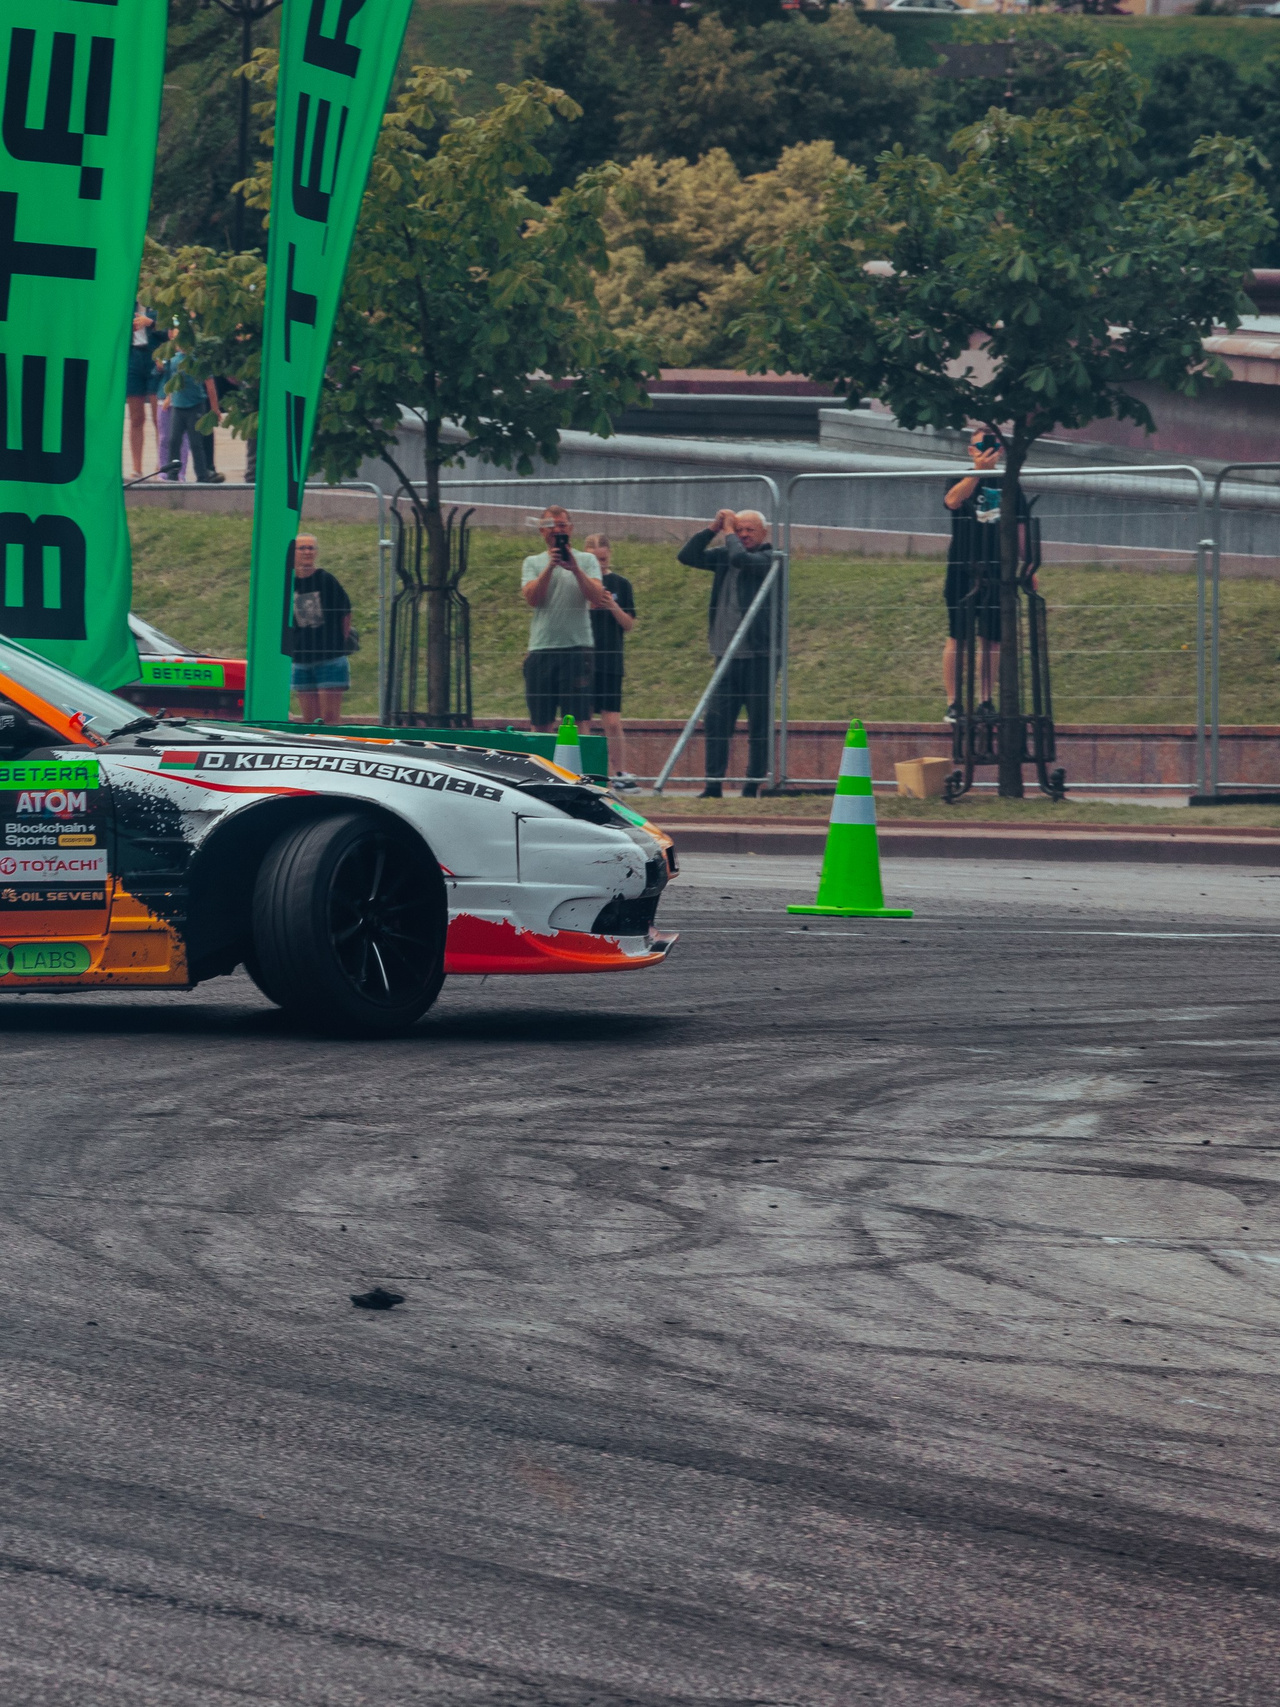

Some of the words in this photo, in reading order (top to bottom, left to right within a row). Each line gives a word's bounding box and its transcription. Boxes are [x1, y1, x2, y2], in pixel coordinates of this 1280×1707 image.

[16, 791, 87, 813] ATOM
[5, 823, 86, 834] Blockchain
[5, 835, 57, 847] Sports
[47, 891, 104, 901] SEVEN
[21, 951, 77, 970] LABS
